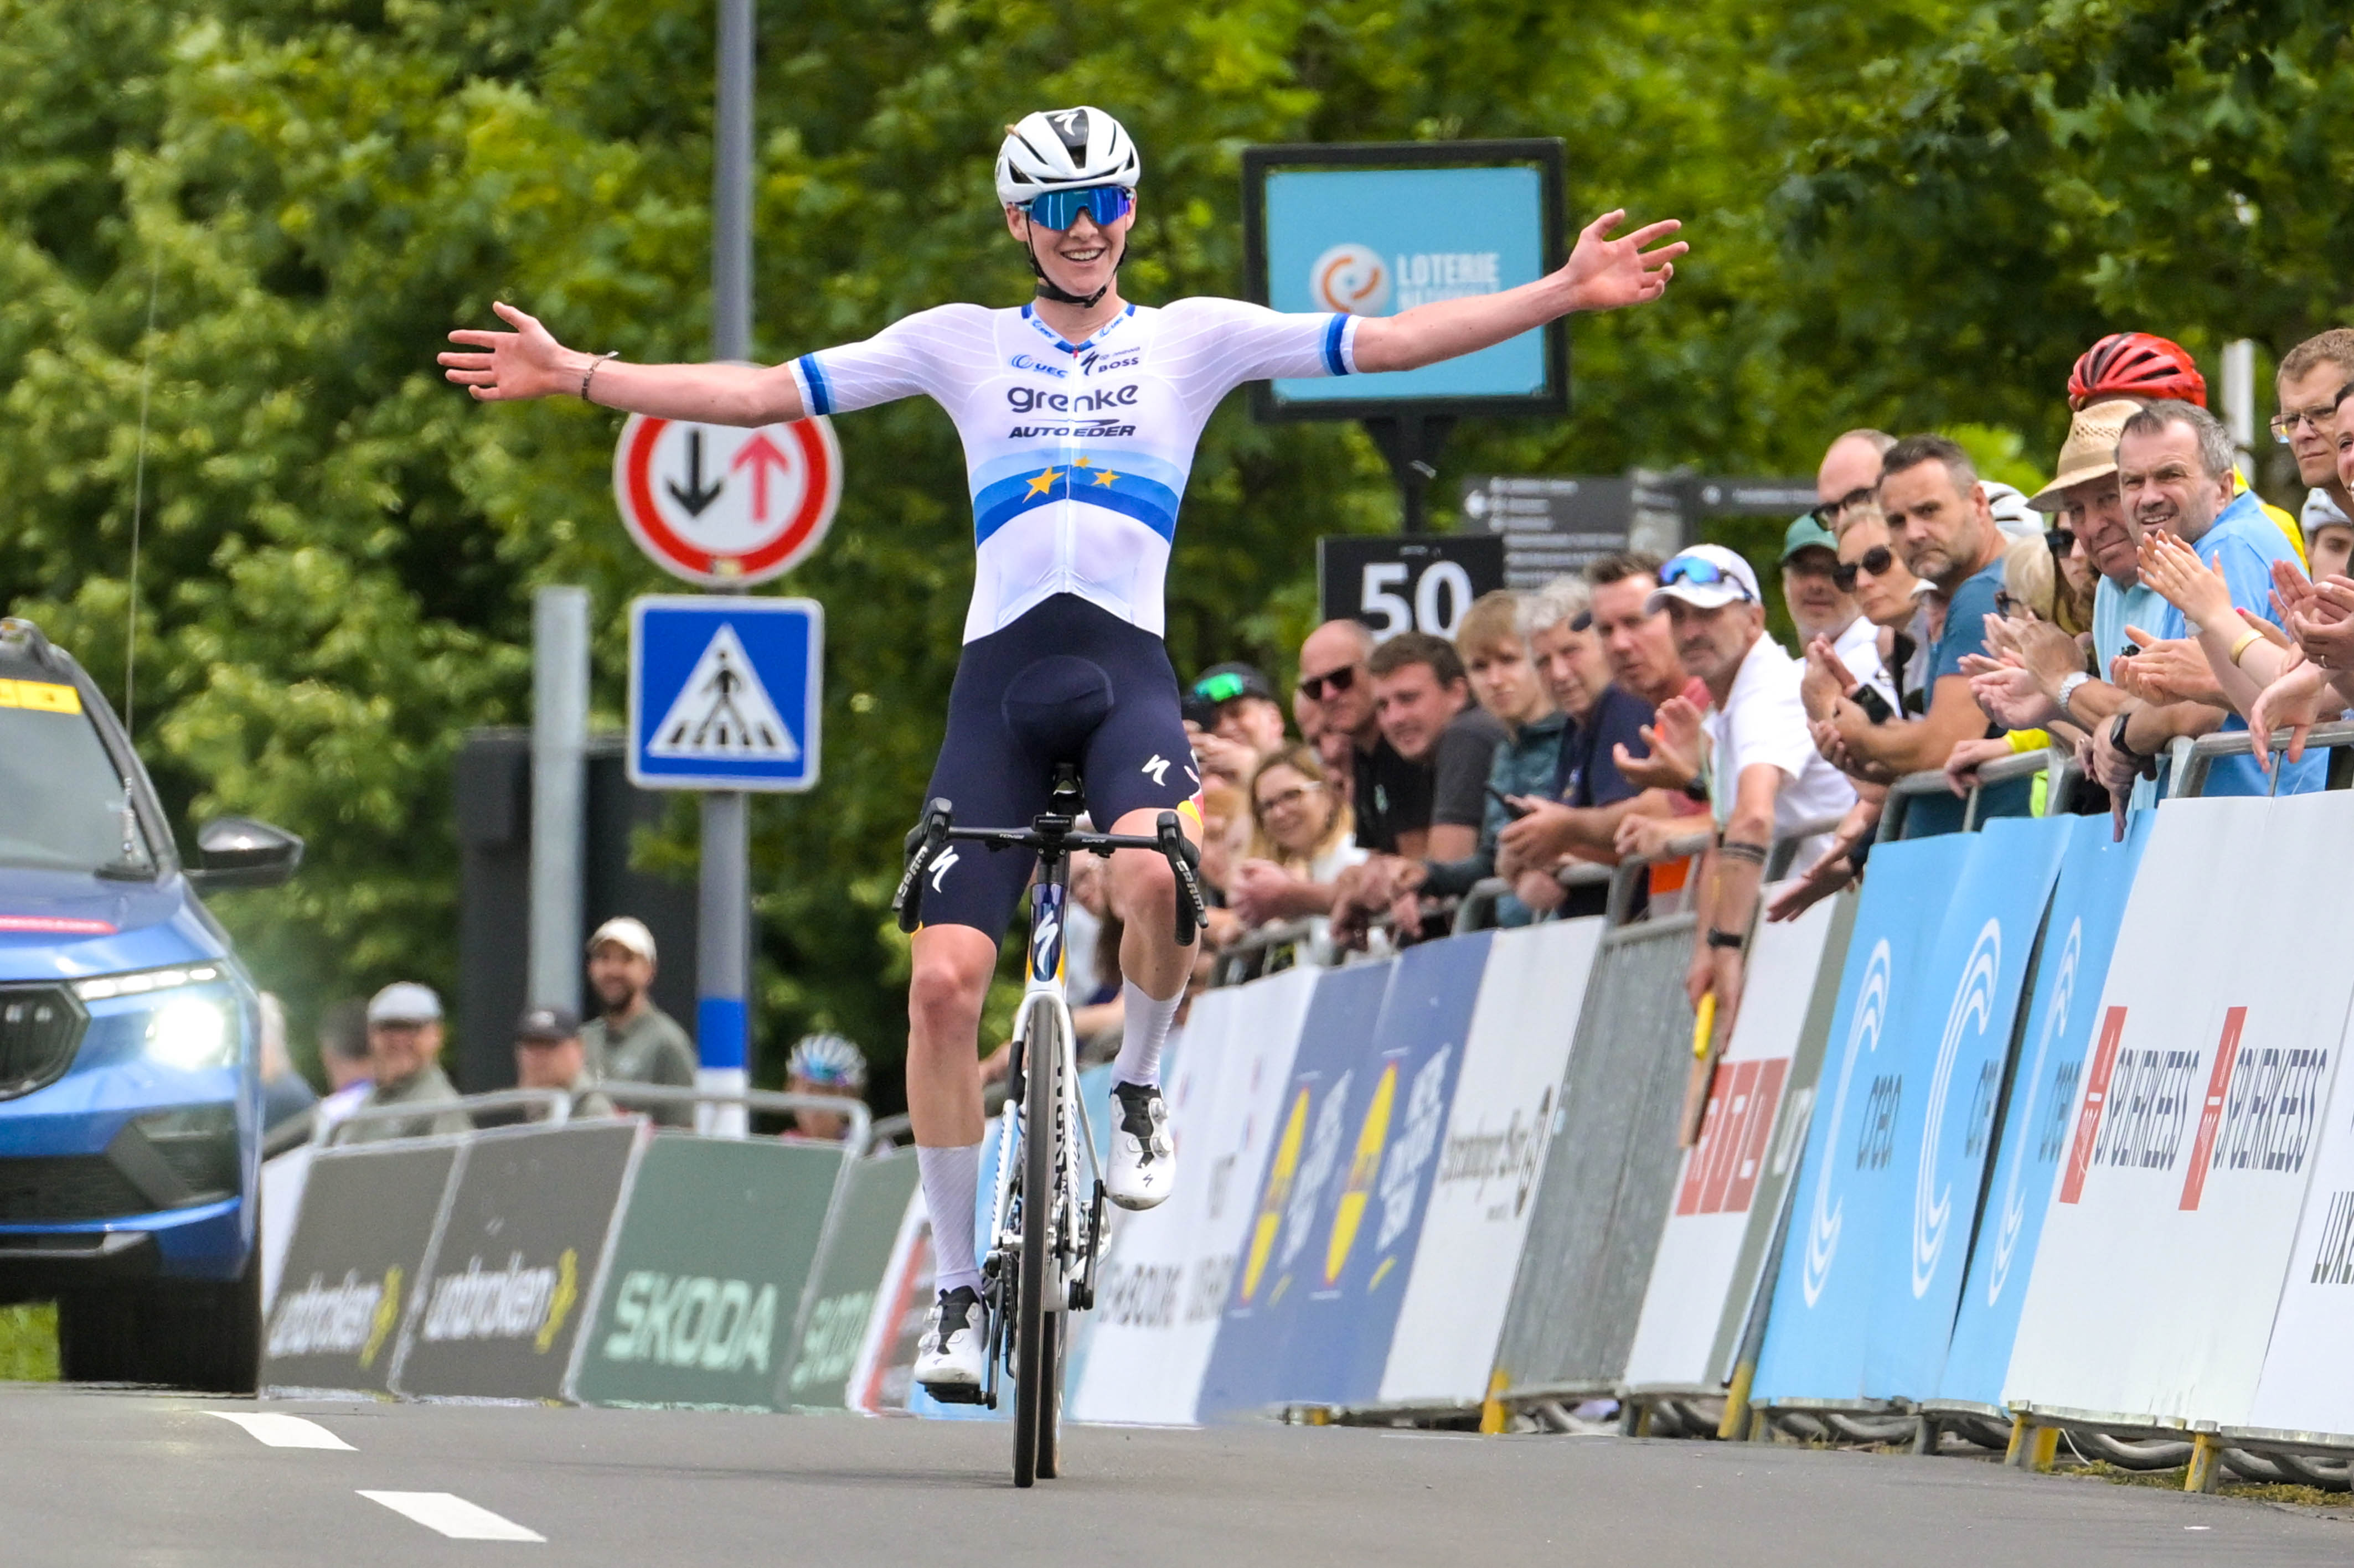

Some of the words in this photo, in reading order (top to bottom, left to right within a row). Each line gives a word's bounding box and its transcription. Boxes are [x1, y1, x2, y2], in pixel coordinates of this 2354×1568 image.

[1098, 357, 1139, 373] BOSS
[1007, 385, 1139, 413] grenke
[1008, 426, 1070, 439] AUTO
[1073, 425, 1136, 437] EDER
[1360, 560, 1473, 645] 50
[897, 846, 928, 897] SRAM
[1176, 860, 1205, 911] SRAM
[2094, 1047, 2200, 1171] SPUERKEESS
[2213, 1046, 2327, 1174] SPUERKEESS
